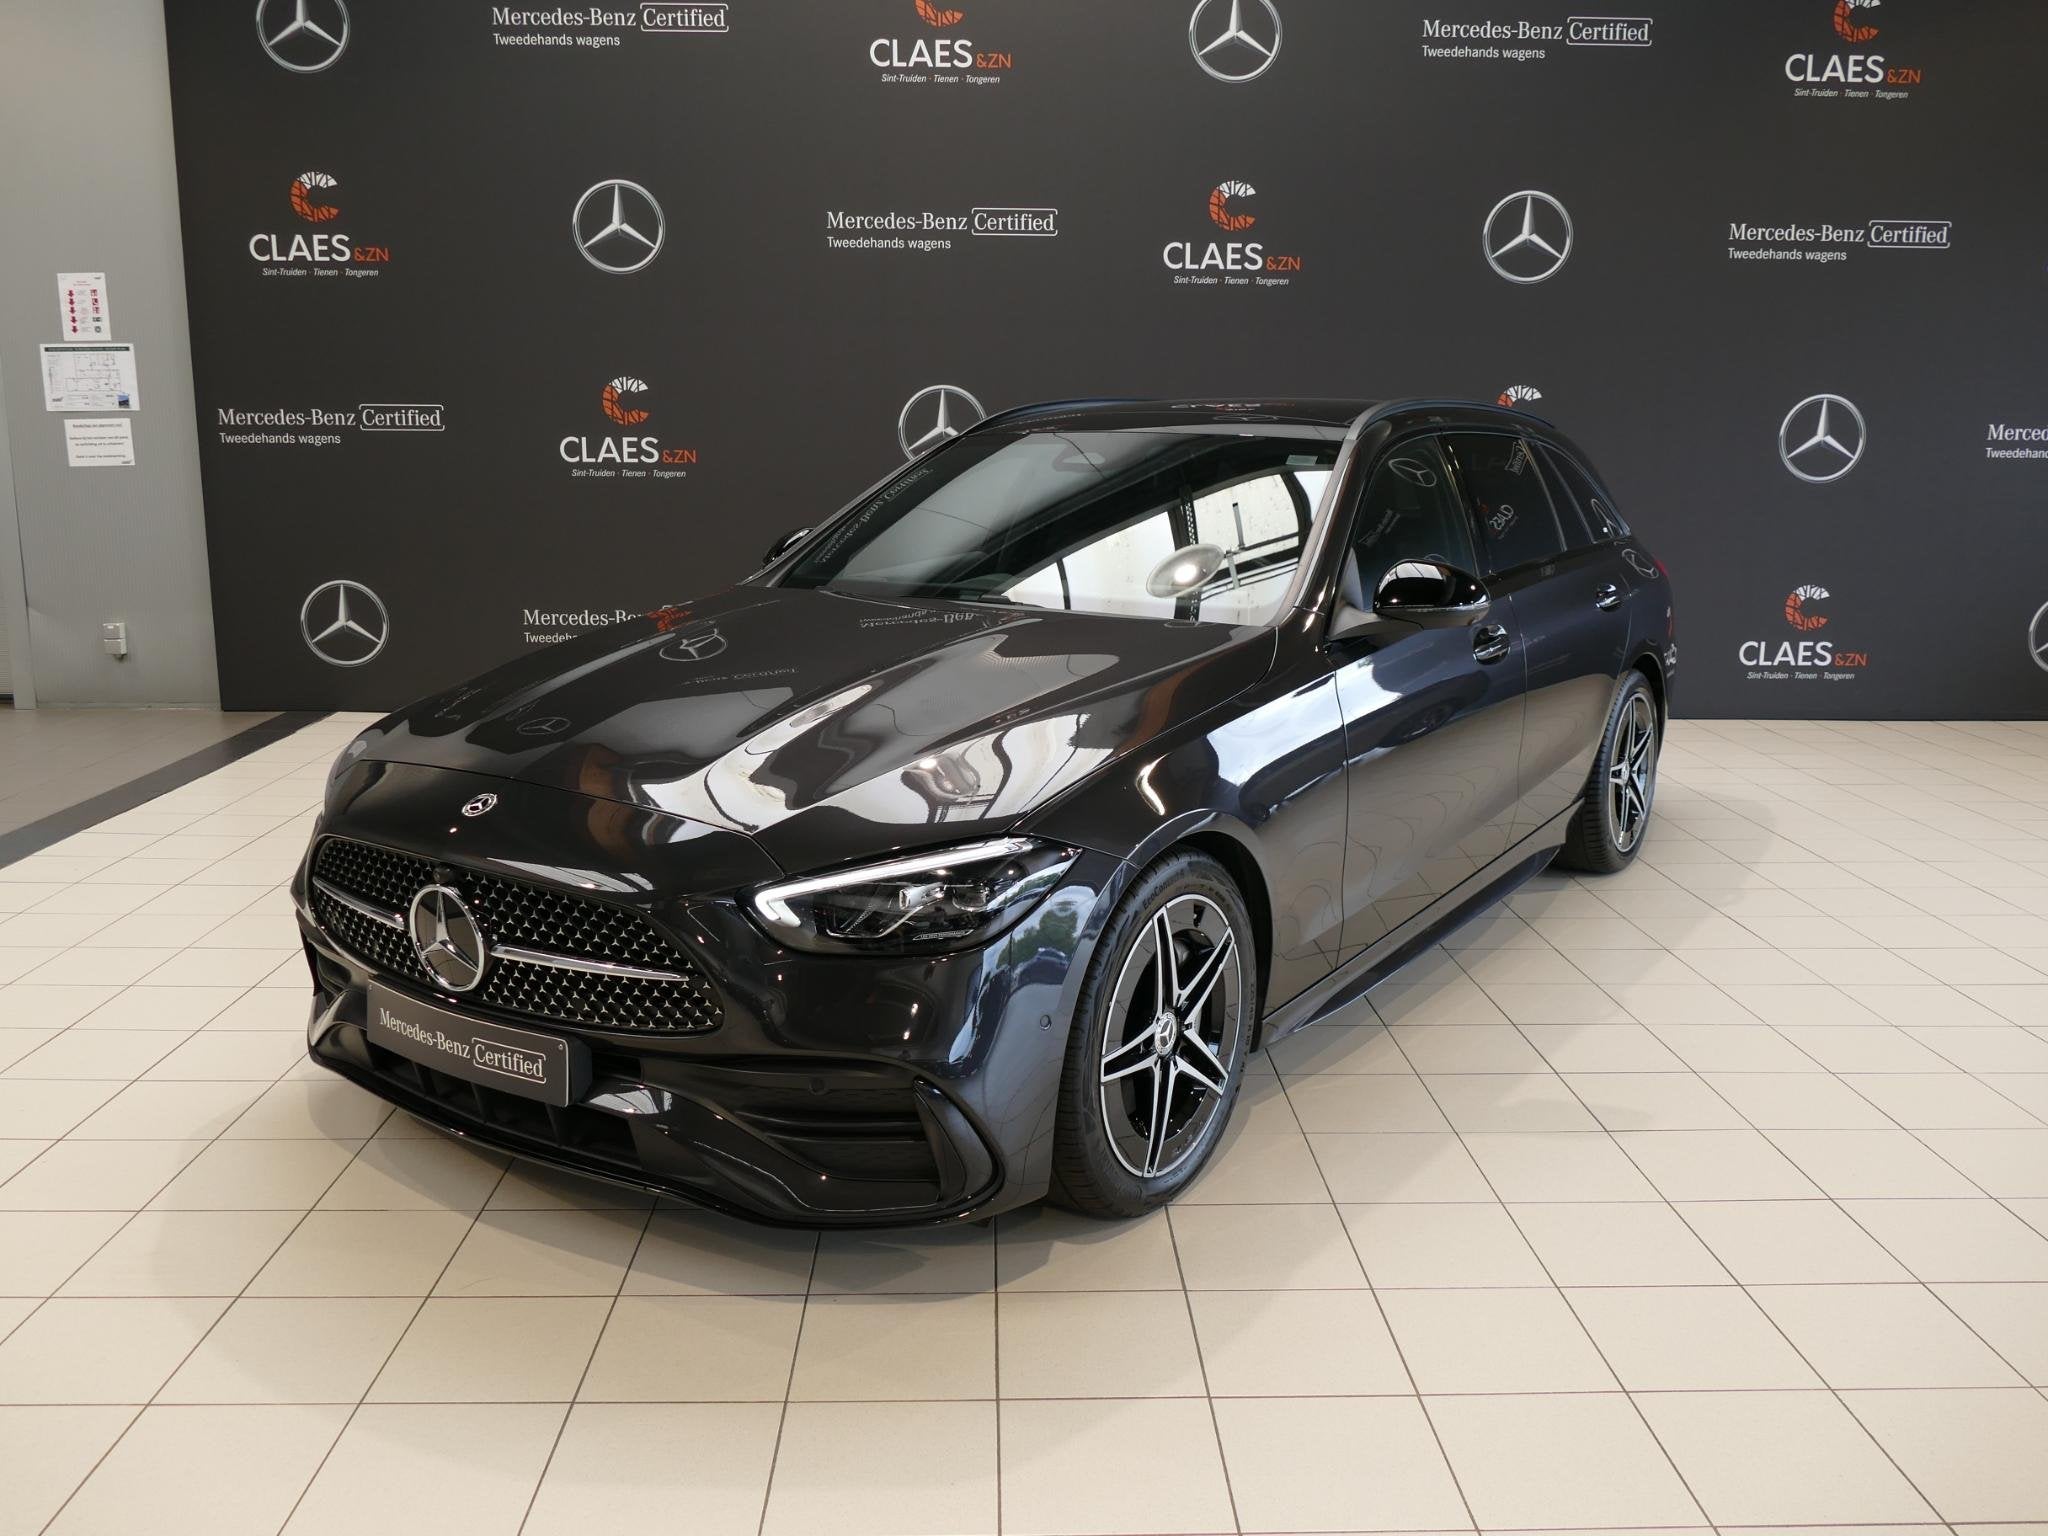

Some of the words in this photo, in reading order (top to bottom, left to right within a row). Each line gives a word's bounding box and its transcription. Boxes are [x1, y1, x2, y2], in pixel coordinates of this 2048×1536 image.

[492, 7, 637, 27] Mercedes-Benz
[643, 7, 726, 27] Certified
[1422, 19, 1563, 40] Mercedes-Benz
[1569, 21, 1650, 41] Certified
[492, 33, 574, 46] Tweedehands
[576, 36, 621, 49] wagens
[869, 38, 973, 69] CLAES
[976, 53, 1012, 69] &ZN
[1421, 44, 1500, 58] Tweedehands
[1502, 49, 1546, 62] wagens
[1784, 53, 1885, 83] CLAES
[1886, 68, 1921, 84] &ZN
[881, 73, 927, 83] Sint-Truiden
[933, 74, 959, 84] Tienen
[966, 74, 1001, 86] Tongeren
[1793, 87, 1839, 97] Sint-Truiden
[1844, 88, 1870, 98] Tienen
[1874, 89, 1909, 101] Tongeren
[826, 211, 968, 230] Mercedes-Benz
[974, 212, 1055, 232] Certified
[1728, 222, 1865, 243] Mercedes-Benz
[1871, 224, 1950, 245] Certified
[248, 233, 352, 262] CLAES
[353, 247, 389, 262] &ZN
[826, 236, 905, 249] Tweedehands
[907, 239, 952, 252] wagens
[1162, 241, 1264, 271] CLAES
[1266, 256, 1301, 271] &ZN
[1727, 247, 1803, 260] Tweedehands
[1804, 251, 1847, 264] wagens
[262, 267, 308, 277] Sint-Truiden
[313, 267, 339, 277] Tienen
[344, 267, 379, 278] Tongeren
[1173, 275, 1219, 285] Sint-Truiden
[1224, 276, 1249, 285] Tienen
[1255, 276, 1290, 287] Tongeren
[217, 408, 357, 426] Mercedes-Benz
[362, 408, 442, 427] Certified
[218, 432, 296, 444] Tweedehands
[298, 435, 342, 447] wagens
[559, 435, 660, 464] CLAES
[662, 449, 697, 464] &ZN
[571, 468, 616, 478] Sint-Truiden
[621, 469, 647, 478] Tienen
[652, 469, 687, 480] Tongeren
[523, 609, 643, 626] Mercedes-B
[523, 631, 578, 643] Tweedeh
[1738, 640, 1833, 667] CLAES
[1834, 653, 1867, 667] &ZN
[1746, 671, 1789, 680] Sint-Truiden
[1794, 671, 1818, 680] Tienen
[1823, 671, 1856, 682] Tongeren
[379, 1007, 471, 1059] Mercedes-Benz
[474, 1042, 544, 1078] Certified
